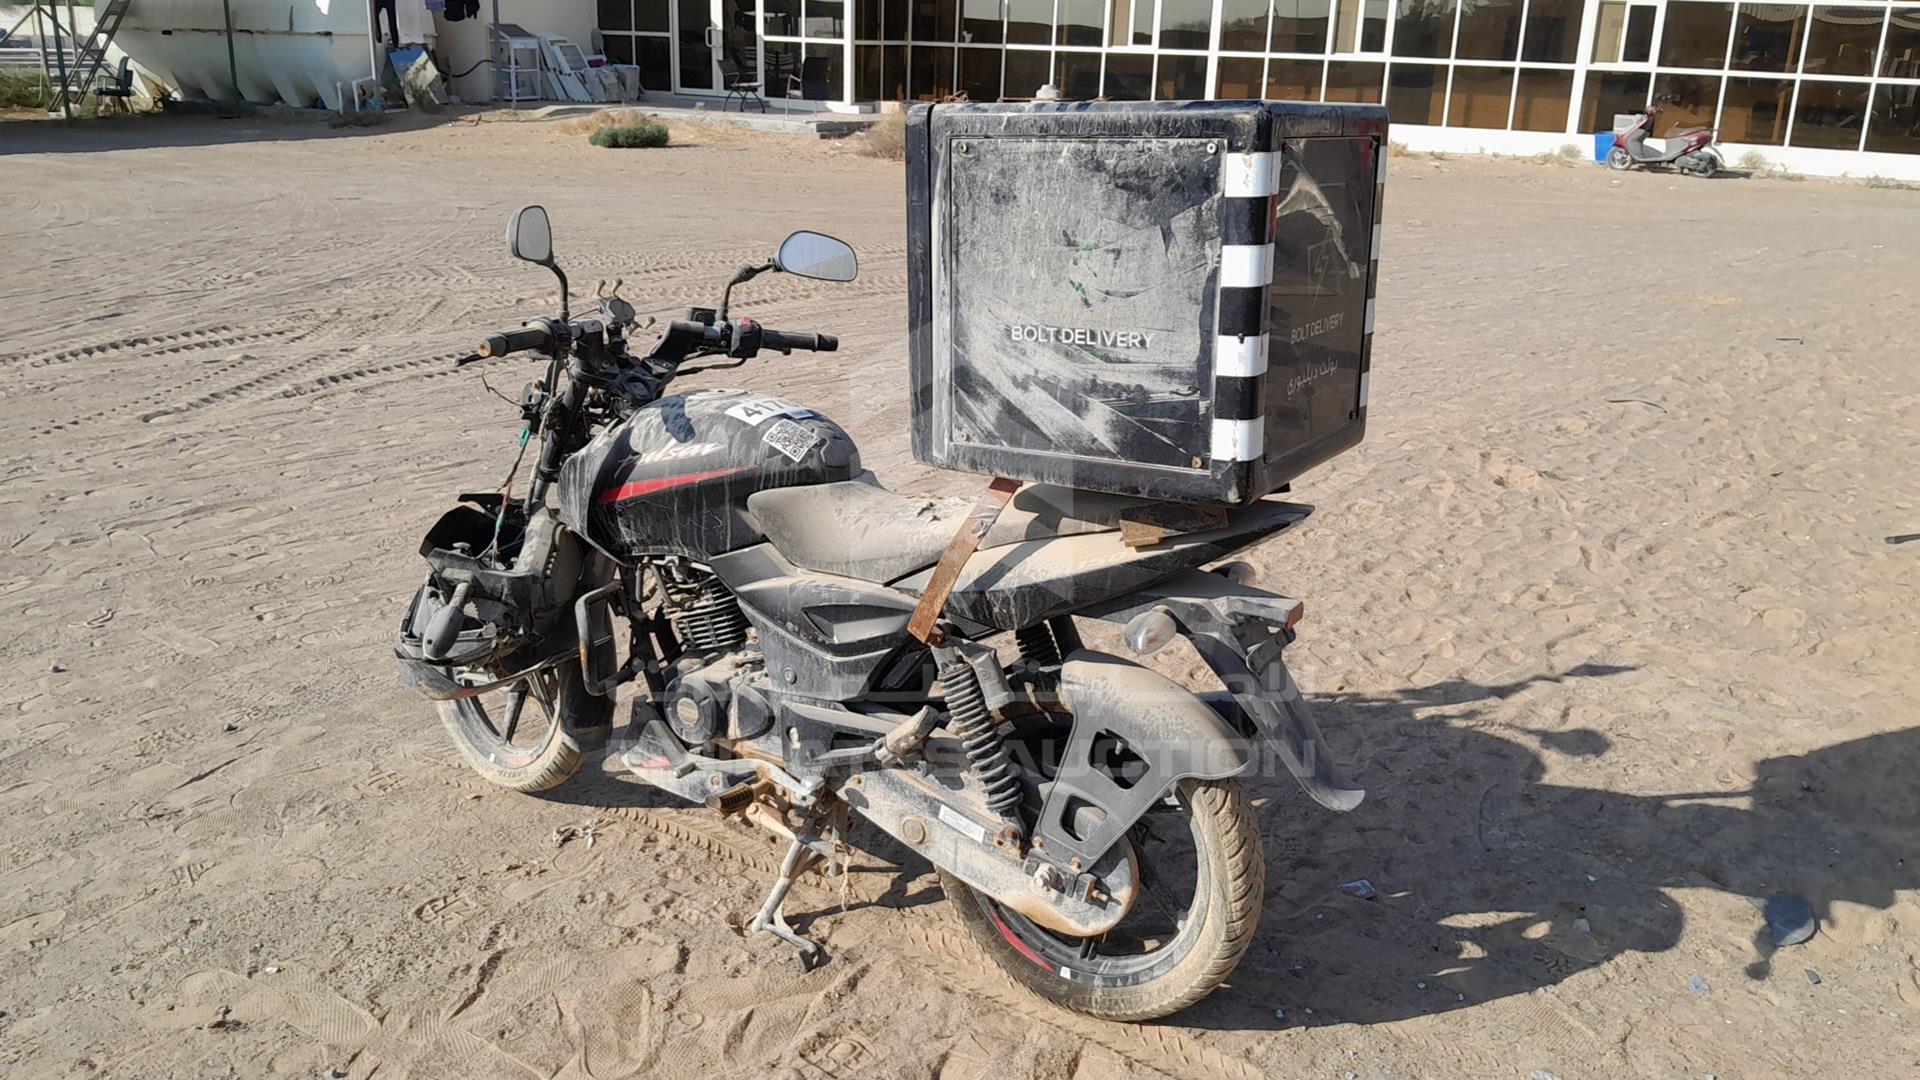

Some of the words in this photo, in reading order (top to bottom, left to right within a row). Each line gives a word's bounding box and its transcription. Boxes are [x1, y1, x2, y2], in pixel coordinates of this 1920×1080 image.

[1011, 325, 1058, 343] BOLT
[1061, 328, 1154, 348] DELIVERY
[1291, 322, 1310, 344] BOLT
[1310, 312, 1344, 337] DELIVERY
